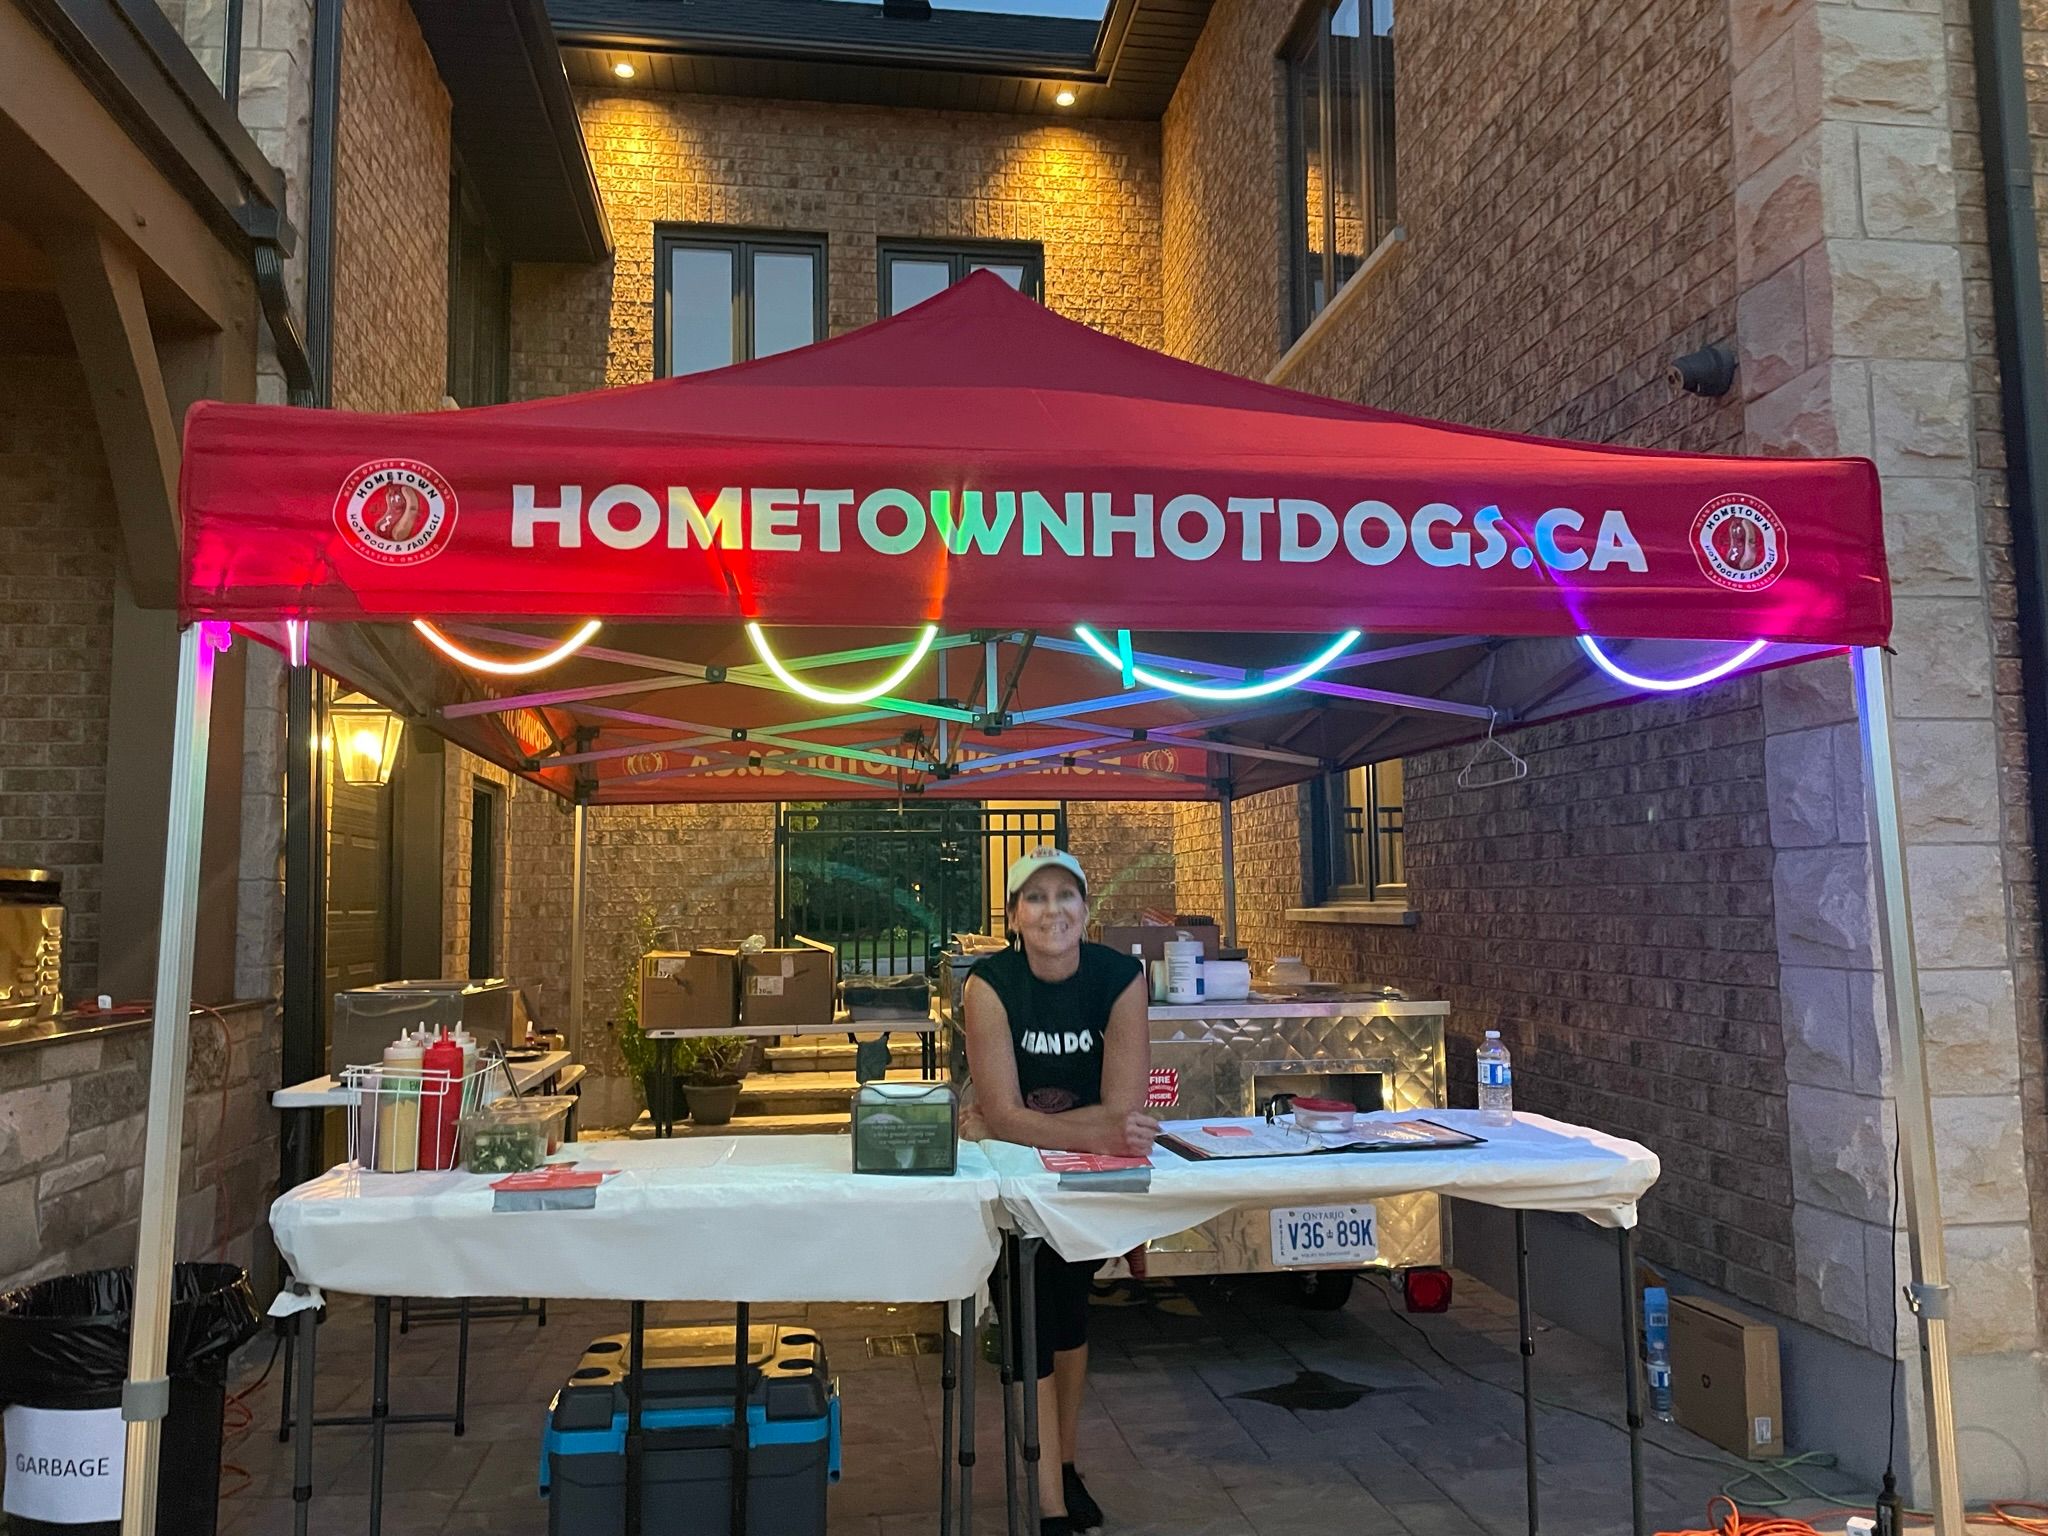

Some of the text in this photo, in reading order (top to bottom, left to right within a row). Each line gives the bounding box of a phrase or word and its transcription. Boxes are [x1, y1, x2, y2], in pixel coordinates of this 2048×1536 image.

[356, 471, 438, 500] HOMETOWN
[511, 483, 1649, 575] HOMETOWNHOTDOGS.CA
[1705, 506, 1771, 531] HOMETOWN
[349, 513, 441, 552] HOT DOGS & SAUSAGES
[1716, 562, 1738, 579] DOGS
[1149, 1075, 1171, 1085] FIRE
[1302, 1211, 1345, 1222] ONTARIO
[1288, 1218, 1373, 1250] V36 89K
[15, 1452, 110, 1478] GARBAGE
